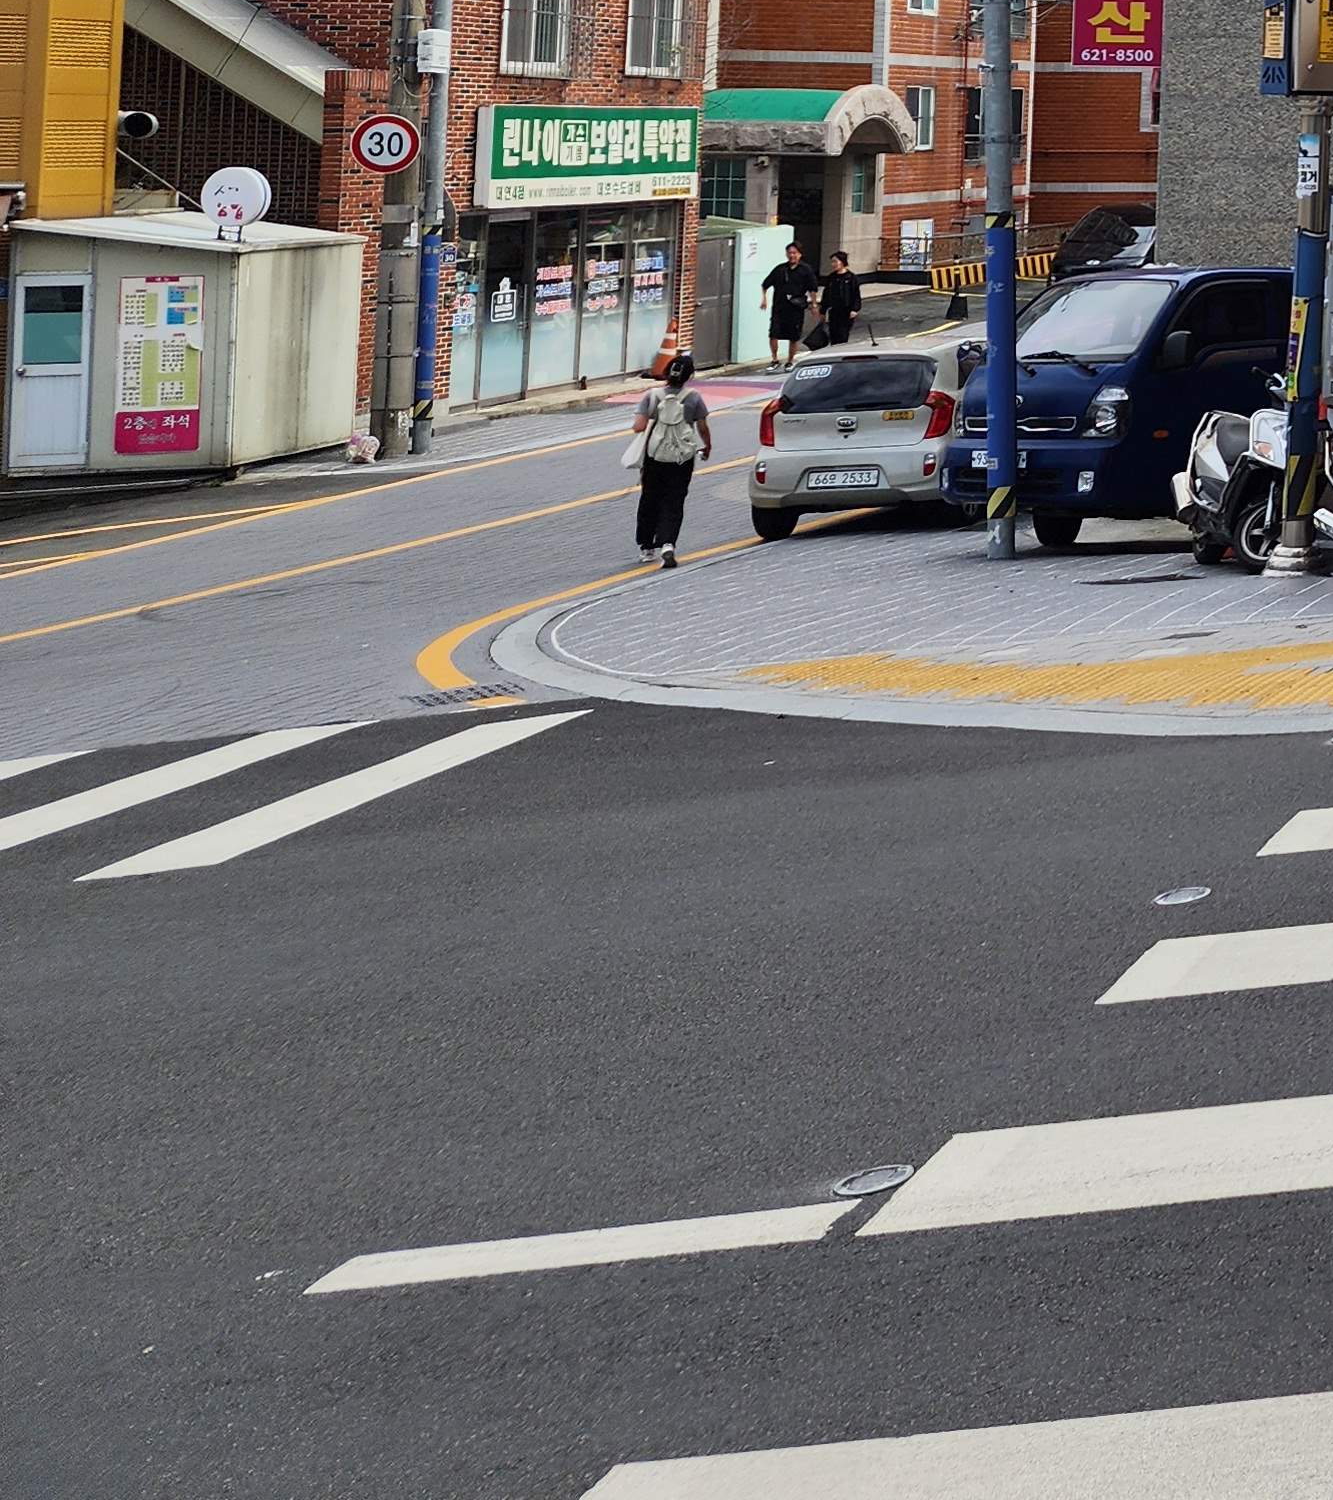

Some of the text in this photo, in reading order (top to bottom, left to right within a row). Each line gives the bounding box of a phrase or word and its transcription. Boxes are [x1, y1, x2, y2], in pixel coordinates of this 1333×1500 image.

[1080, 49, 1154, 62] 621-8500
[367, 131, 404, 157] 30
[502, 119, 692, 167] 린나이 보일러 특약점
[842, 472, 872, 484] 2533
